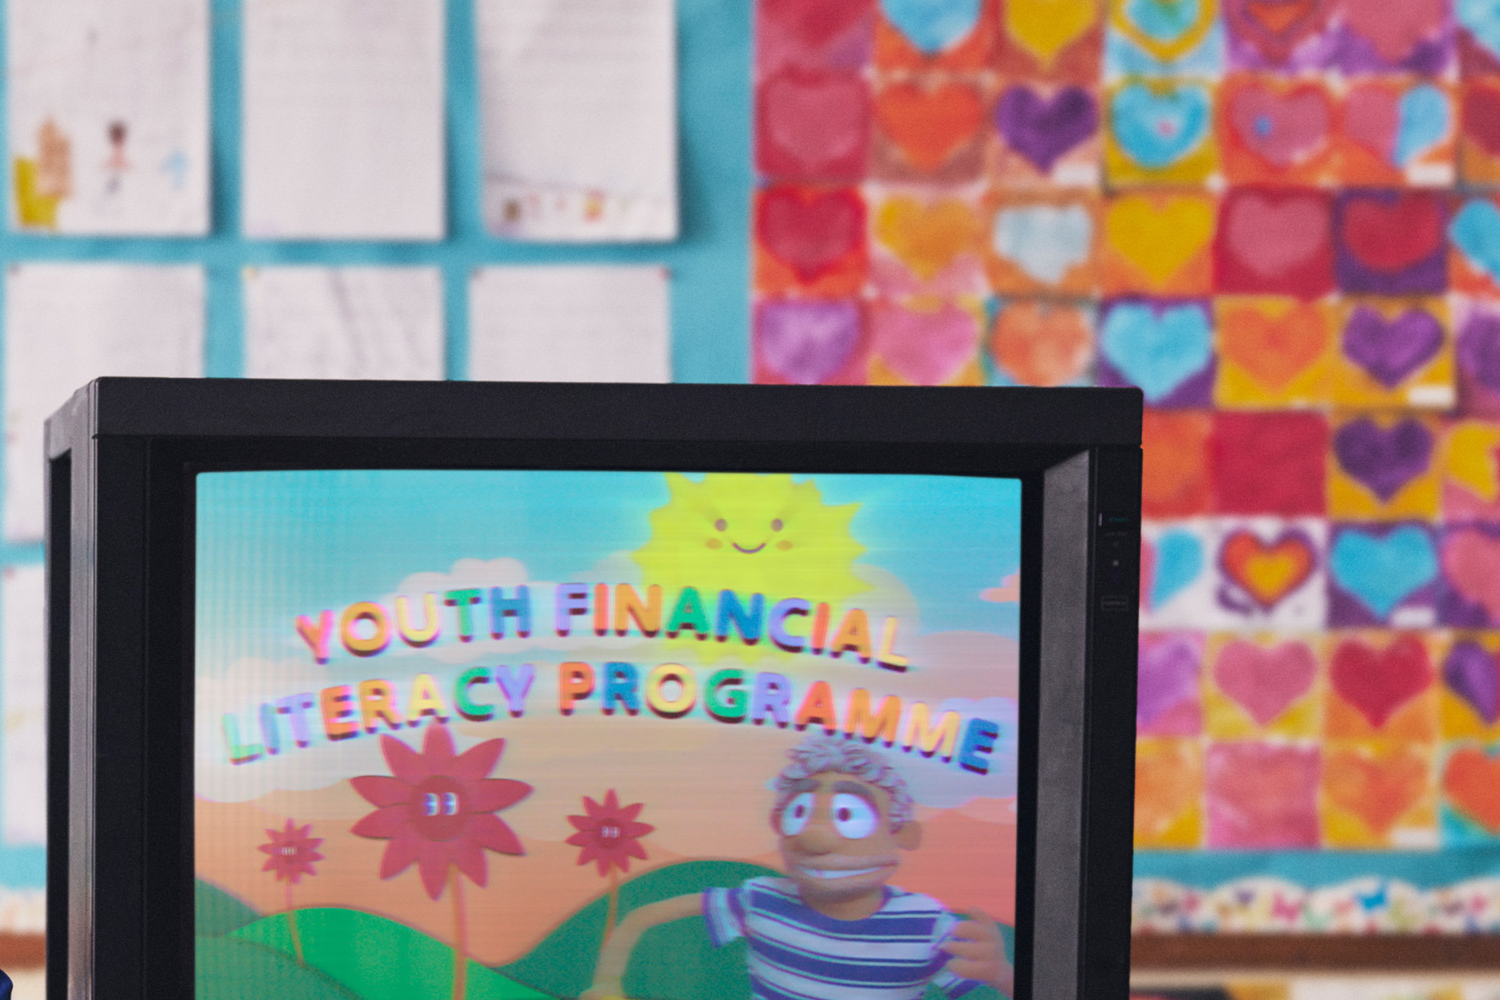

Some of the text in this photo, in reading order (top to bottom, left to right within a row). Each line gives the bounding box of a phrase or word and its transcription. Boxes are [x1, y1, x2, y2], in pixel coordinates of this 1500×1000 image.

[294, 582, 911, 672] YOUTH FINANCIAL
[220, 660, 1000, 775] LITERACY PROGRAMME
